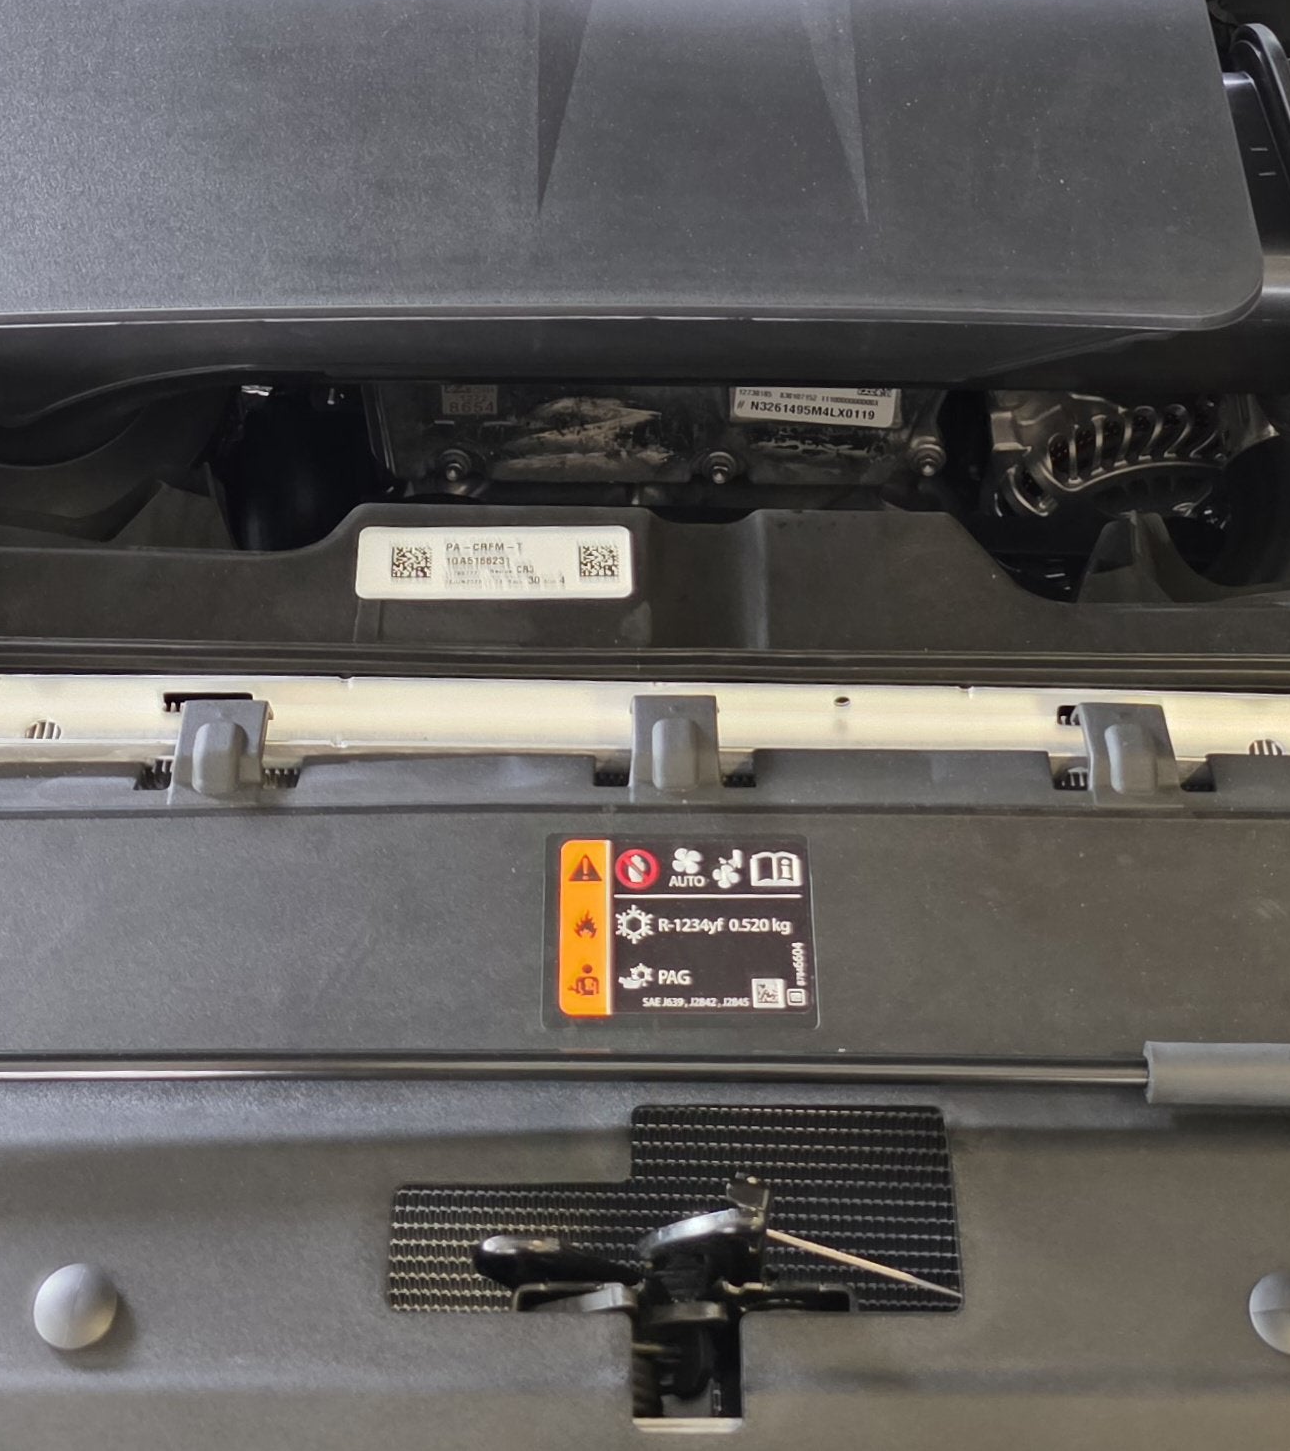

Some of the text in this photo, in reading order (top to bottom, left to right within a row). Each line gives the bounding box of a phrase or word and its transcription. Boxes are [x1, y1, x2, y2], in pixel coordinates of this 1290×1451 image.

[750, 400, 876, 421] N3261495M4LX0119
[668, 875, 706, 888] AUTO
[658, 917, 794, 936] R-1234yf 0.520 kg
[658, 969, 692, 985] PAG
[641, 997, 661, 1007] SAE
